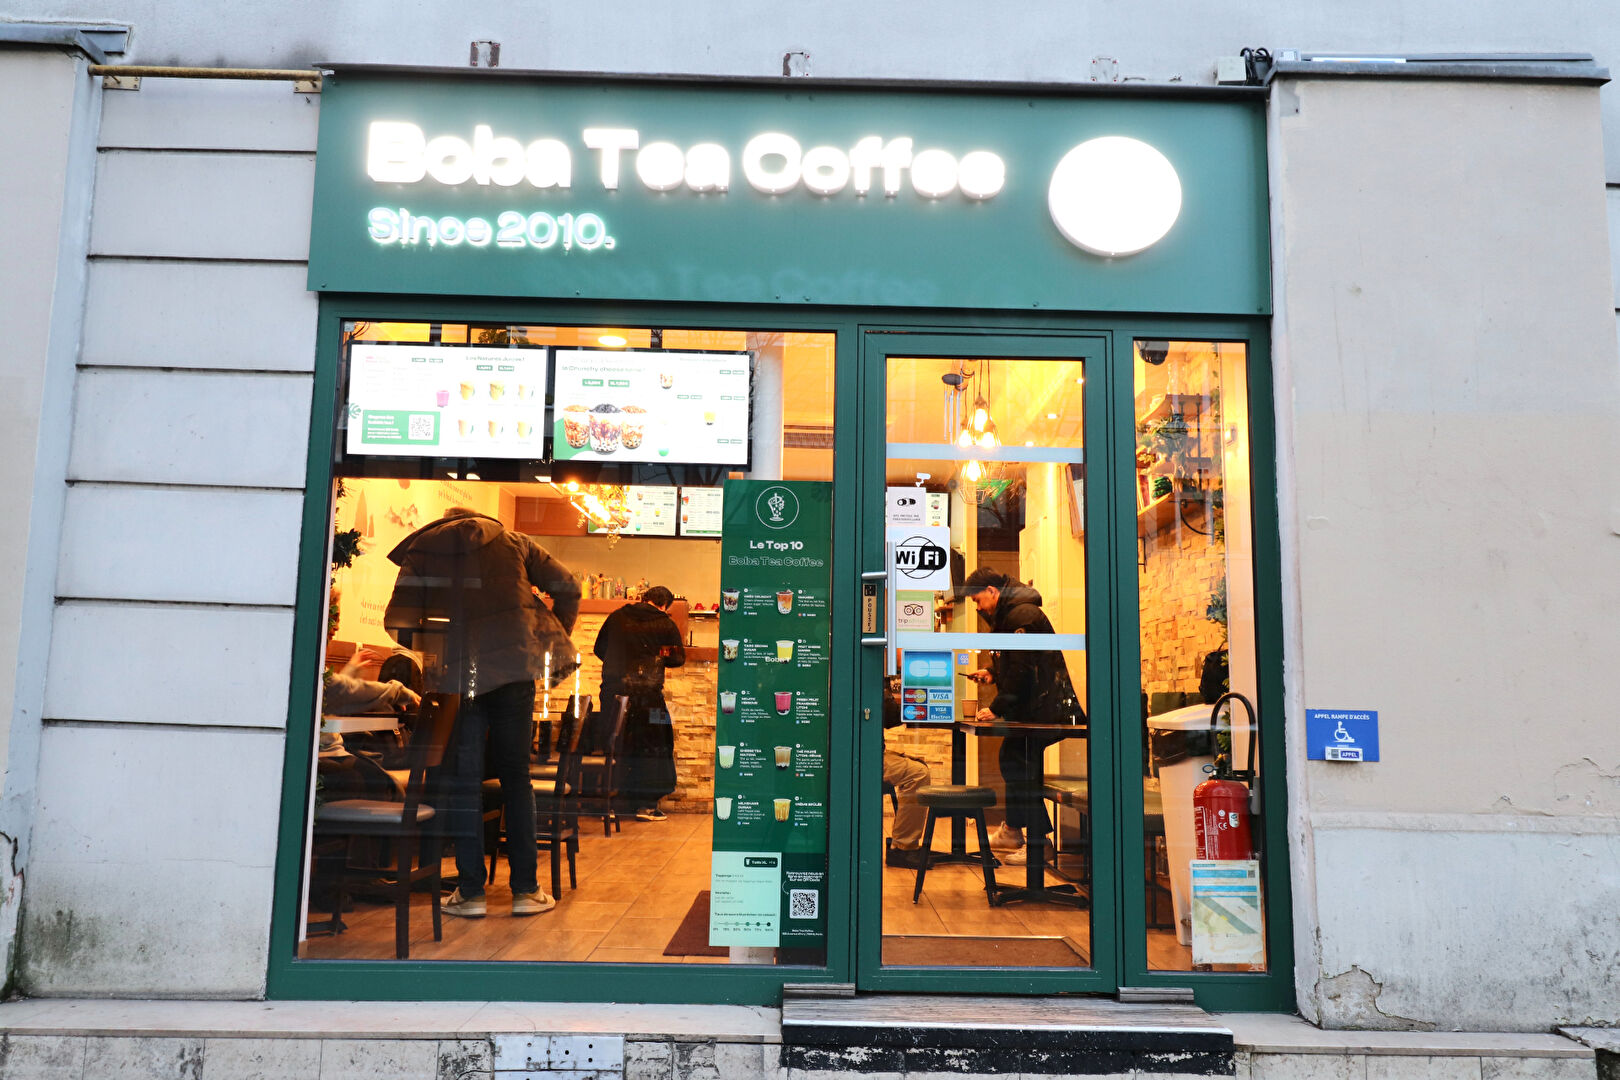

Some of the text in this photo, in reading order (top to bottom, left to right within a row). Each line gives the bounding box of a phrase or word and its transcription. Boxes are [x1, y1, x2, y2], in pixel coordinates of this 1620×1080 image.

[367, 121, 1006, 199] Boba Tea Coffee
[367, 206, 493, 248] Since
[749, 540, 804, 551] Le Top 10
[728, 555, 824, 567] Boba Tea Coffee
